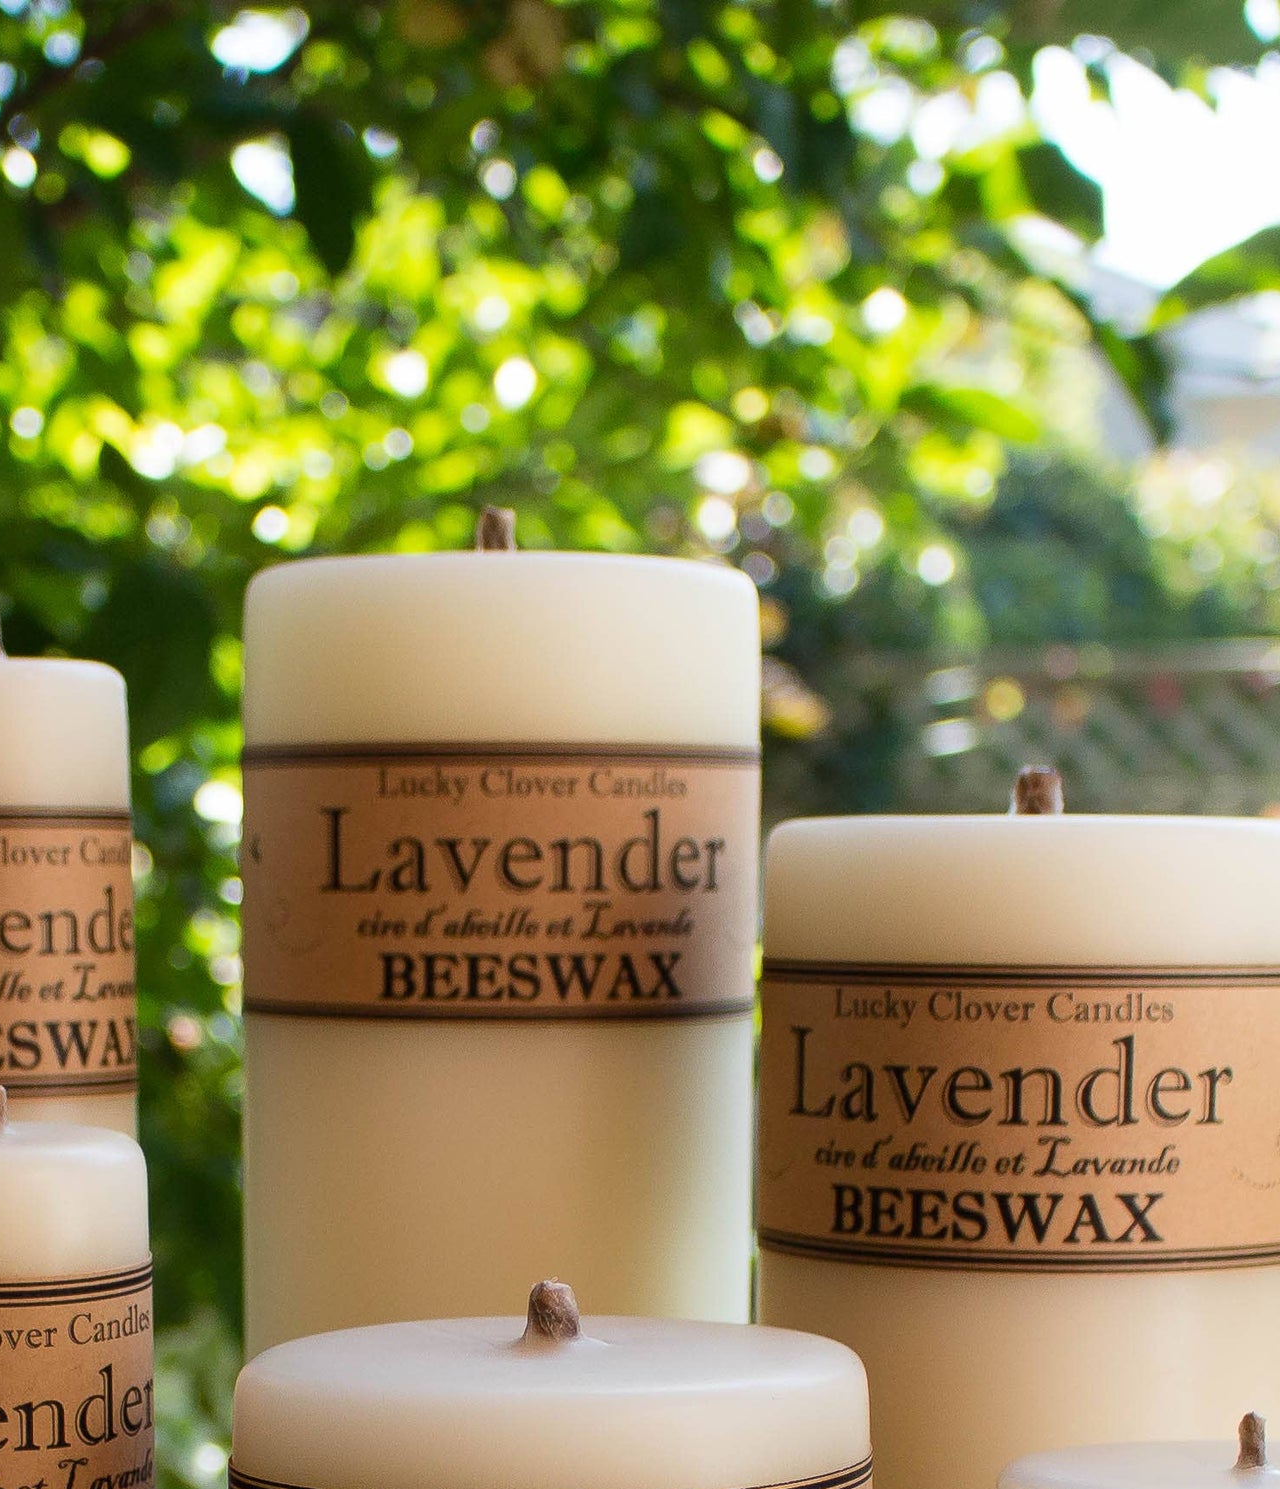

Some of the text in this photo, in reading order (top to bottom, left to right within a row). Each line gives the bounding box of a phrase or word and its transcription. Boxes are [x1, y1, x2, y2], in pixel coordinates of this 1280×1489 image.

[377, 766, 687, 804] Lucky Clover Candles
[320, 806, 725, 894] Lavender
[546, 912, 573, 938] et
[379, 951, 683, 1001] BEESWAX
[834, 987, 1175, 1027] Lucky Clover Candles
[788, 1026, 1234, 1129] Lavender
[994, 1150, 1025, 1177] et
[1034, 1135, 1181, 1179] Lavande
[830, 1183, 1166, 1245] BEESWAX
